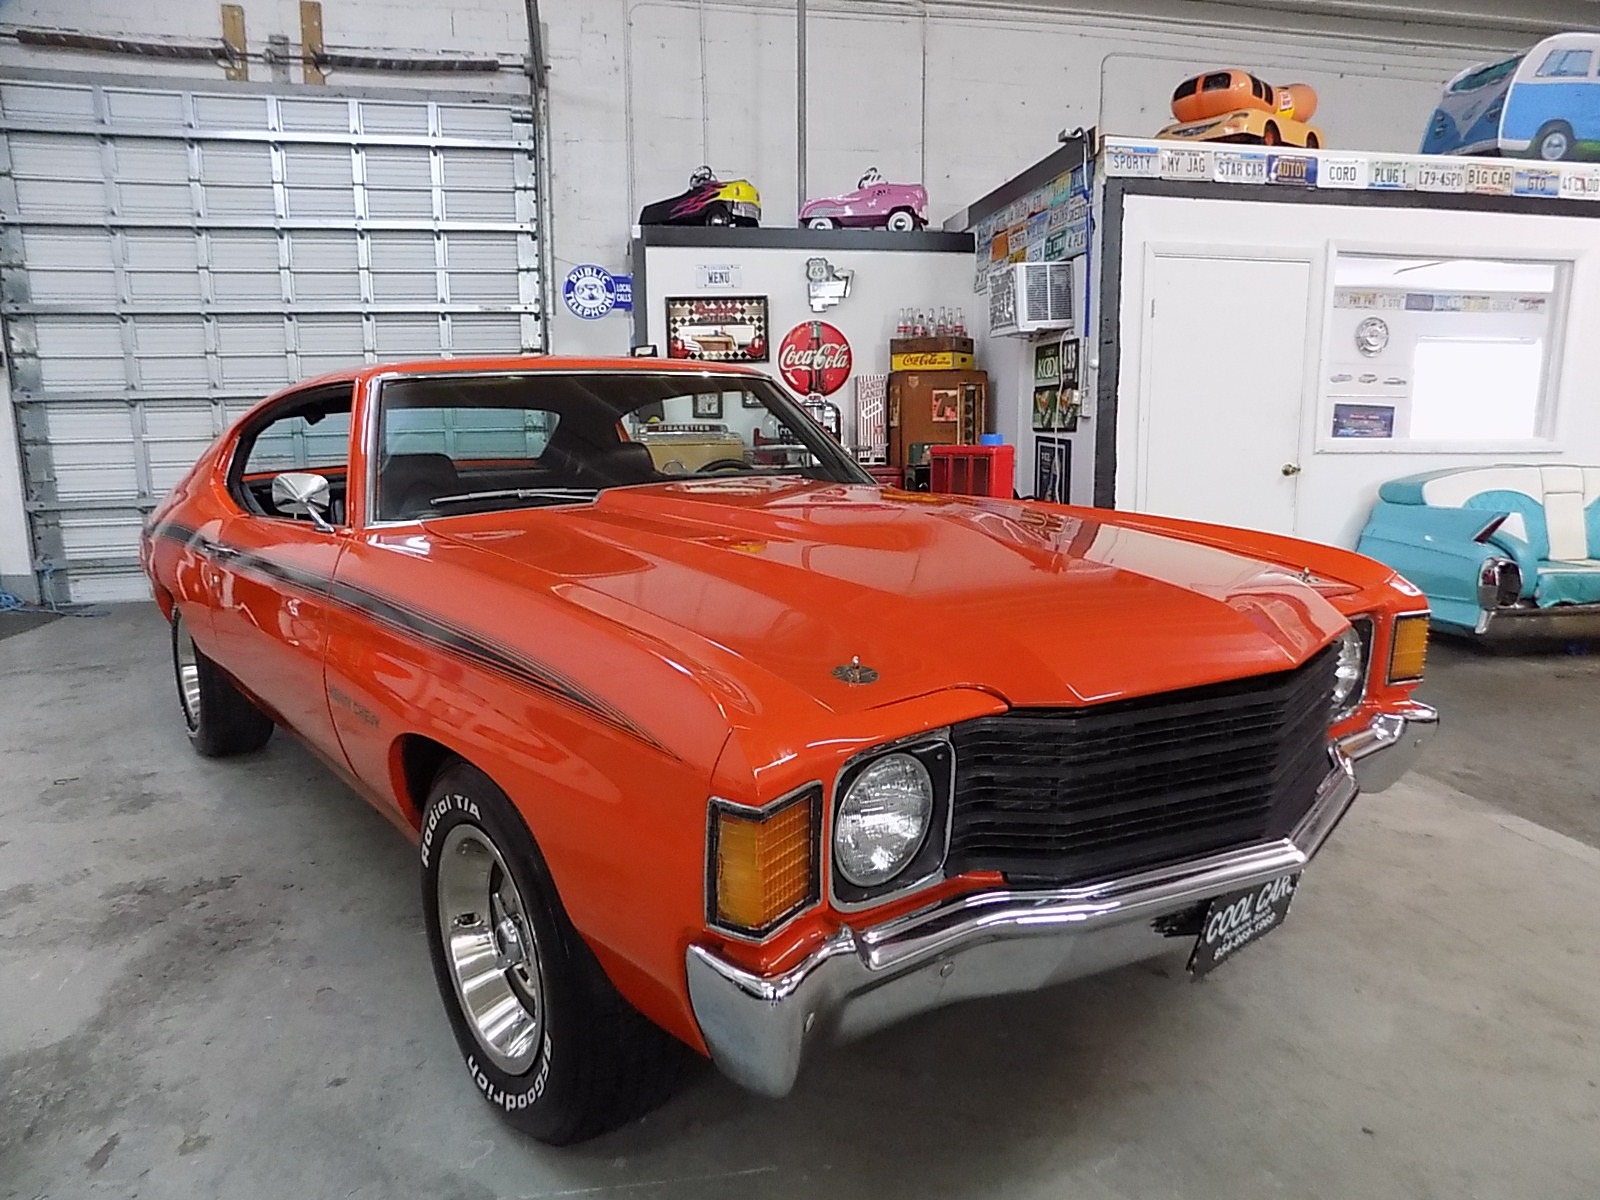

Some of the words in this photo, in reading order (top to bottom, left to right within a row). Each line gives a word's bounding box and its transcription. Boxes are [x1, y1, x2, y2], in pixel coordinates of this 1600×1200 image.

[1113, 155, 1152, 170] SPORTY
[1167, 156, 1181, 172] MY
[1186, 157, 1206, 173] JAG
[1218, 161, 1243, 176] STAR
[1245, 162, 1265, 177] CAR
[1328, 165, 1358, 182] CORD
[1374, 167, 1399, 183] PLUG
[1468, 169, 1488, 185] BIG
[1490, 170, 1512, 187] CAR
[1527, 175, 1547, 192] GTO
[569, 266, 611, 285] PUBLIC
[707, 271, 730, 284] MENU
[616, 283, 632, 293] LOCAL
[565, 291, 614, 318] TELEPHONE
[616, 293, 632, 303] CALLS
[421, 794, 452, 869] Radial
[1206, 892, 1254, 945] COOL
[467, 1030, 552, 1113] BFGoodrich
